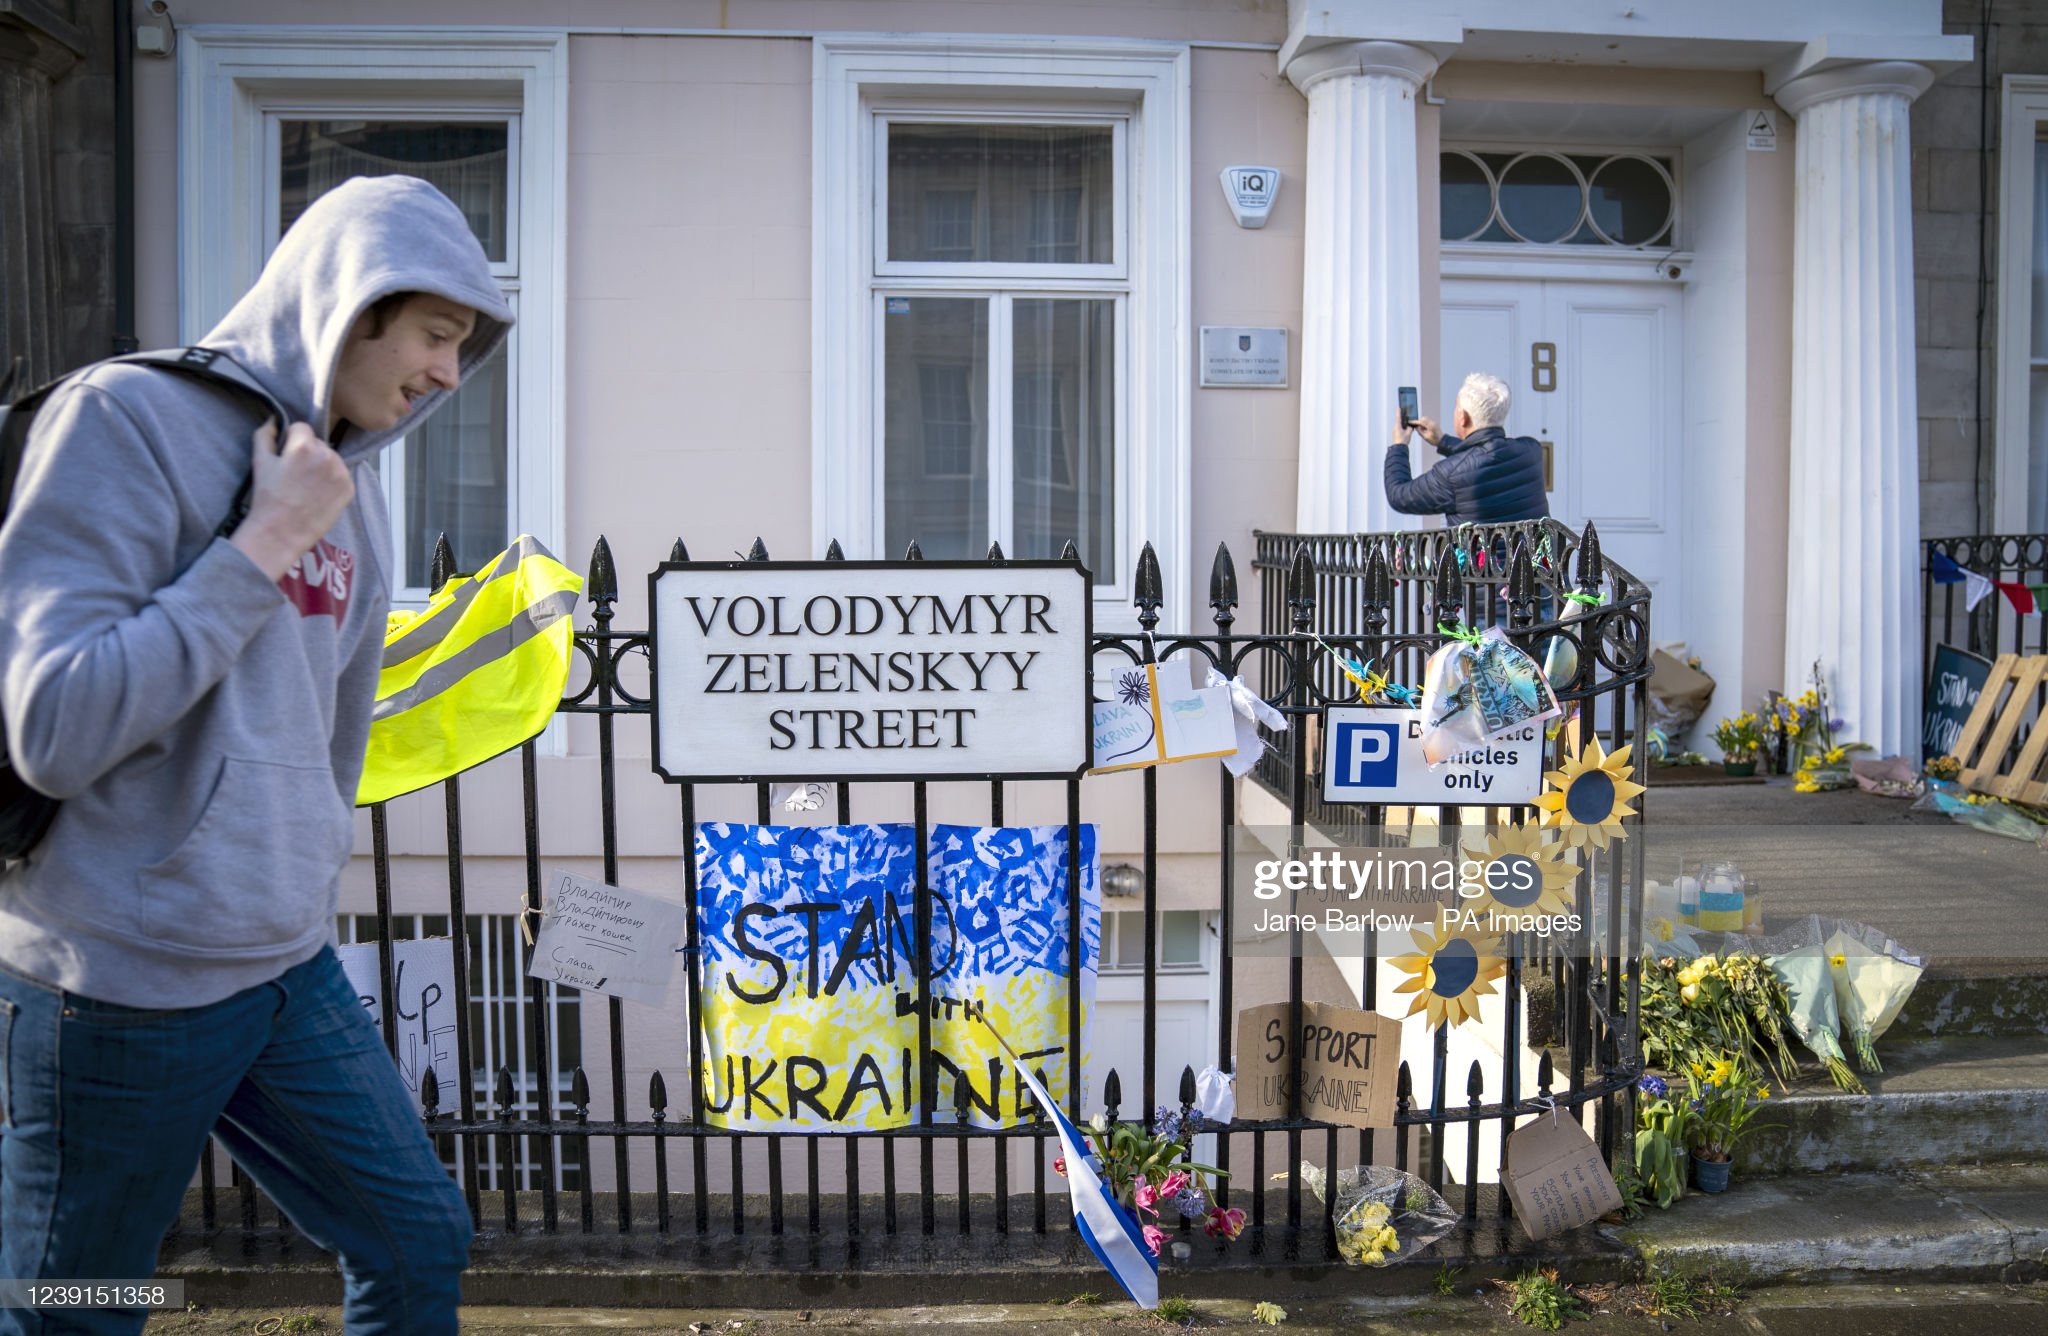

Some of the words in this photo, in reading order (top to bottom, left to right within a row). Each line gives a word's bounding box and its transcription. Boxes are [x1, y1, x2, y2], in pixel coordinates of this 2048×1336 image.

[1242, 174, 1264, 192] iQ
[1531, 342, 1557, 392] 8
[684, 594, 1058, 637] VOLODYMYR
[703, 651, 1040, 694] ZELENSKYY
[769, 708, 976, 751] STREET
[1094, 706, 1132, 728] LAVA
[1350, 730, 1390, 782] P
[1444, 770, 1494, 793] only
[726, 887, 957, 1005] STAND
[1265, 1018, 1377, 1070] SPPORT
[704, 1047, 1065, 1123] UKRAINE
